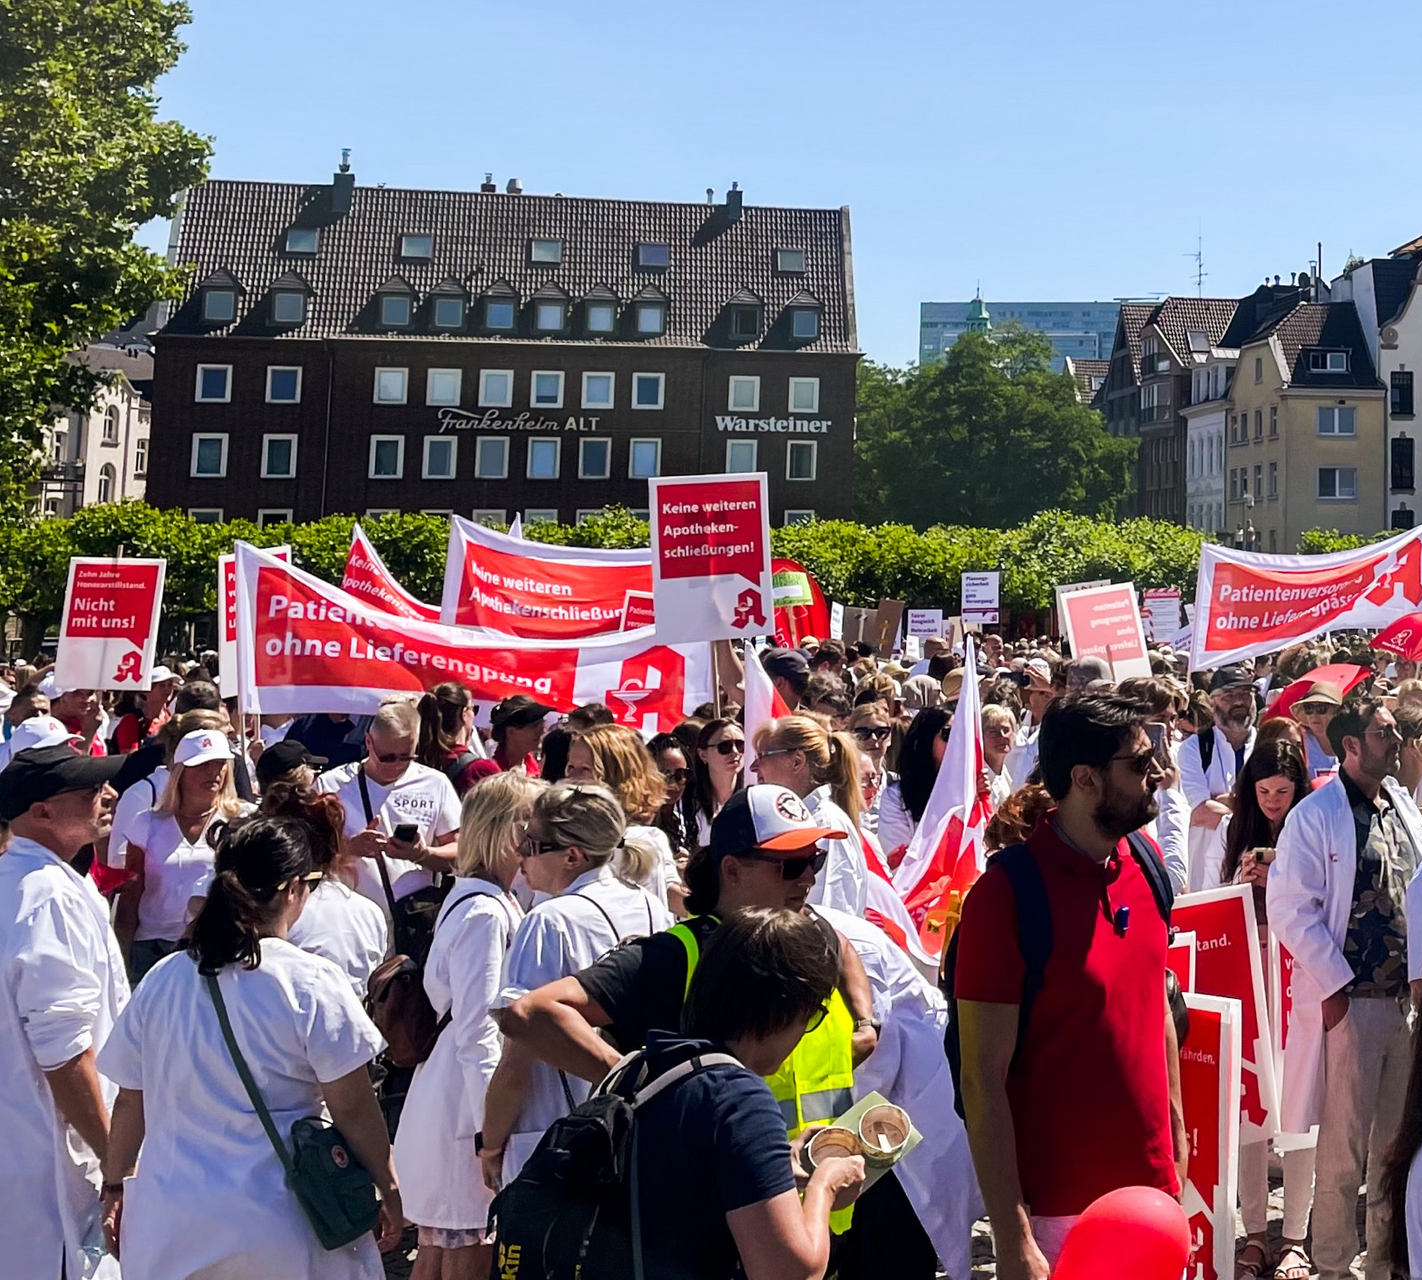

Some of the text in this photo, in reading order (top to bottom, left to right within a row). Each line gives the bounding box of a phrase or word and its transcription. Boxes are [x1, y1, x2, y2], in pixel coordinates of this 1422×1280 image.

[438, 407, 601, 432] Frankenheim ALT
[714, 415, 832, 433] Warsteiner
[662, 499, 757, 515] Keine weiteren
[663, 522, 739, 538] Apotheken-
[664, 541, 755, 560] schließungen!
[503, 576, 572, 596] weiteren
[74, 597, 115, 612] Nicht
[71, 614, 135, 629] mit uns!
[1216, 612, 1259, 630] ohne
[265, 631, 342, 658] ohne
[394, 799, 435, 809] SPORT
